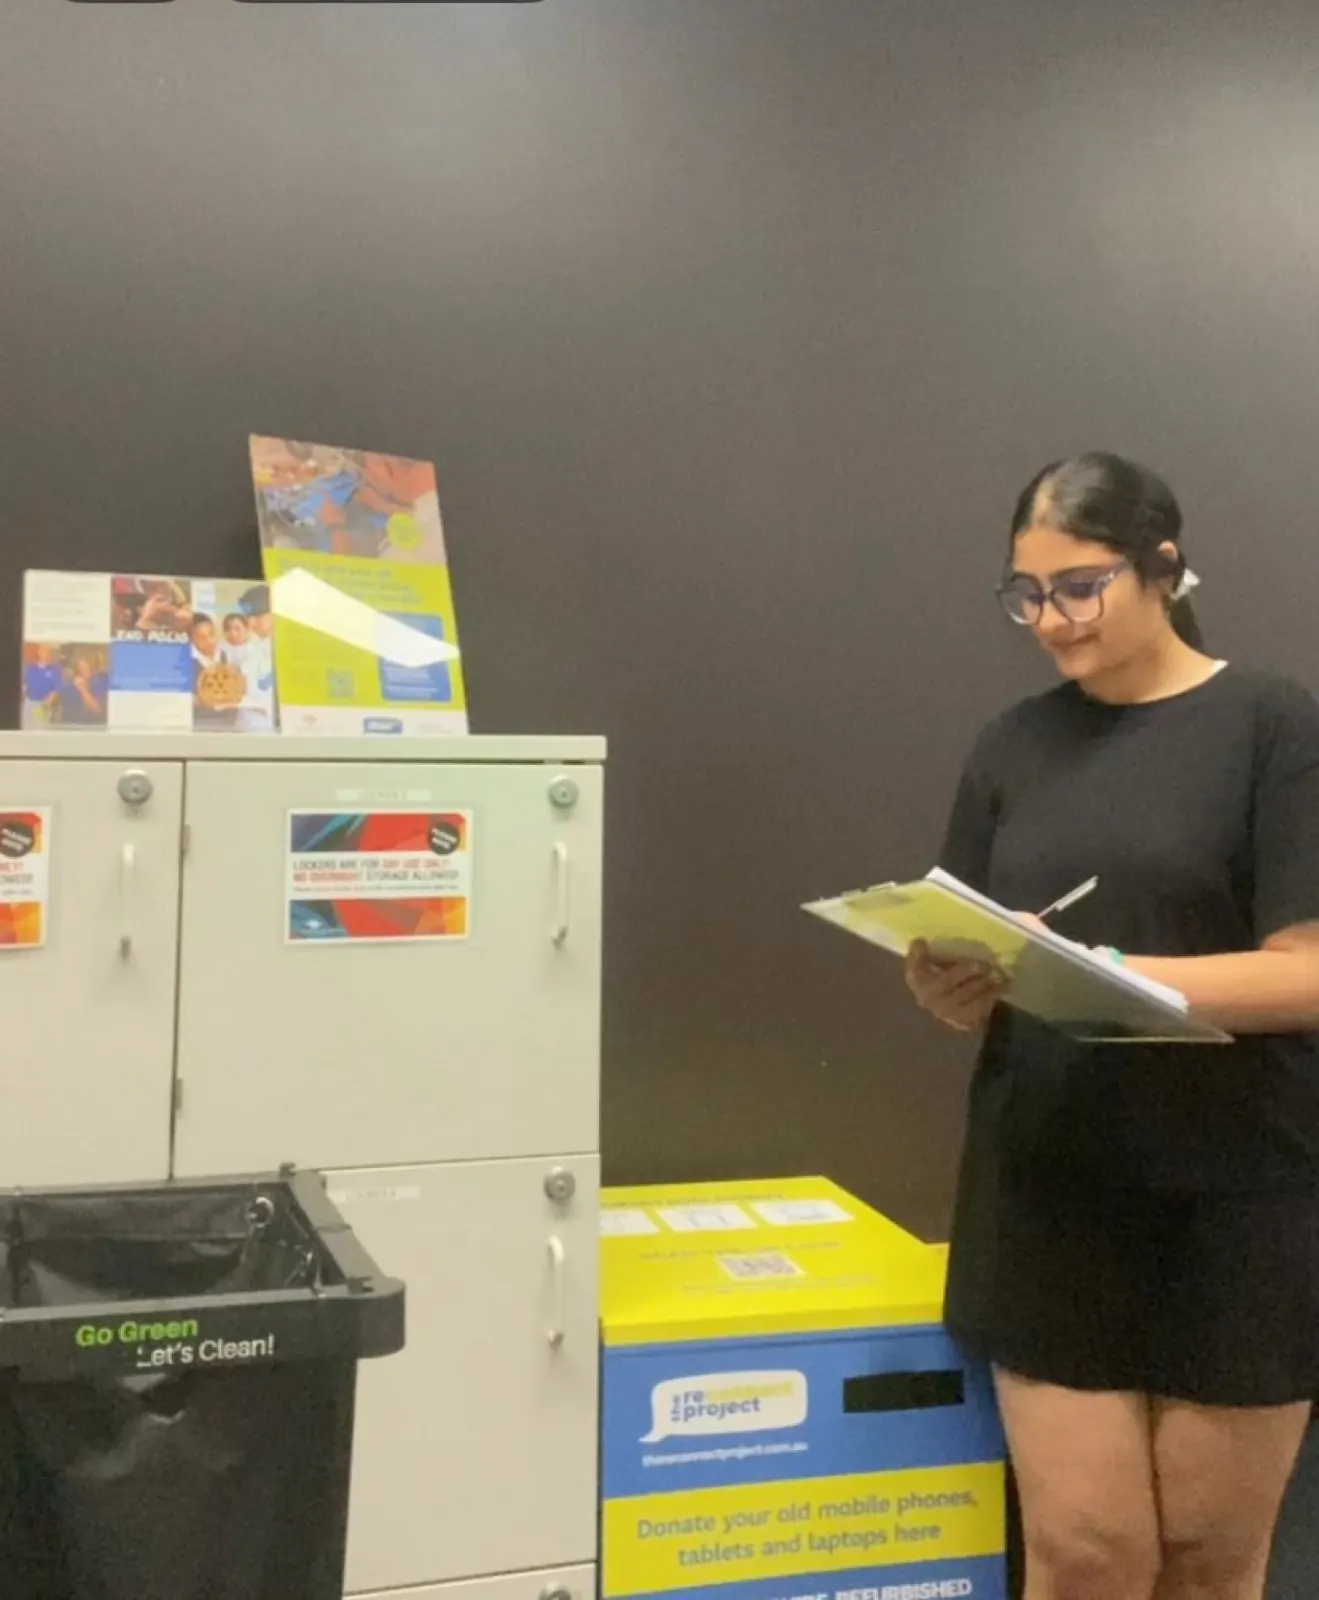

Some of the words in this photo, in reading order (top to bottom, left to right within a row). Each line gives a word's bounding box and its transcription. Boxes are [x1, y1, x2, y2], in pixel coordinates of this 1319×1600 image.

[76, 1325, 113, 1346] Go
[118, 1319, 198, 1342] Green
[199, 1333, 275, 1362] Clean!
[683, 1397, 761, 1422] project
[637, 1514, 715, 1540] Donate
[722, 1510, 771, 1534] your
[777, 1501, 811, 1522] old
[818, 1495, 890, 1519] mobile
[897, 1489, 979, 1518] phones,
[678, 1543, 754, 1567] tablets
[762, 1535, 801, 1555] and
[808, 1525, 888, 1552] laptops
[895, 1522, 942, 1542] here
[835, 1578, 972, 1600] REFURBISHED
